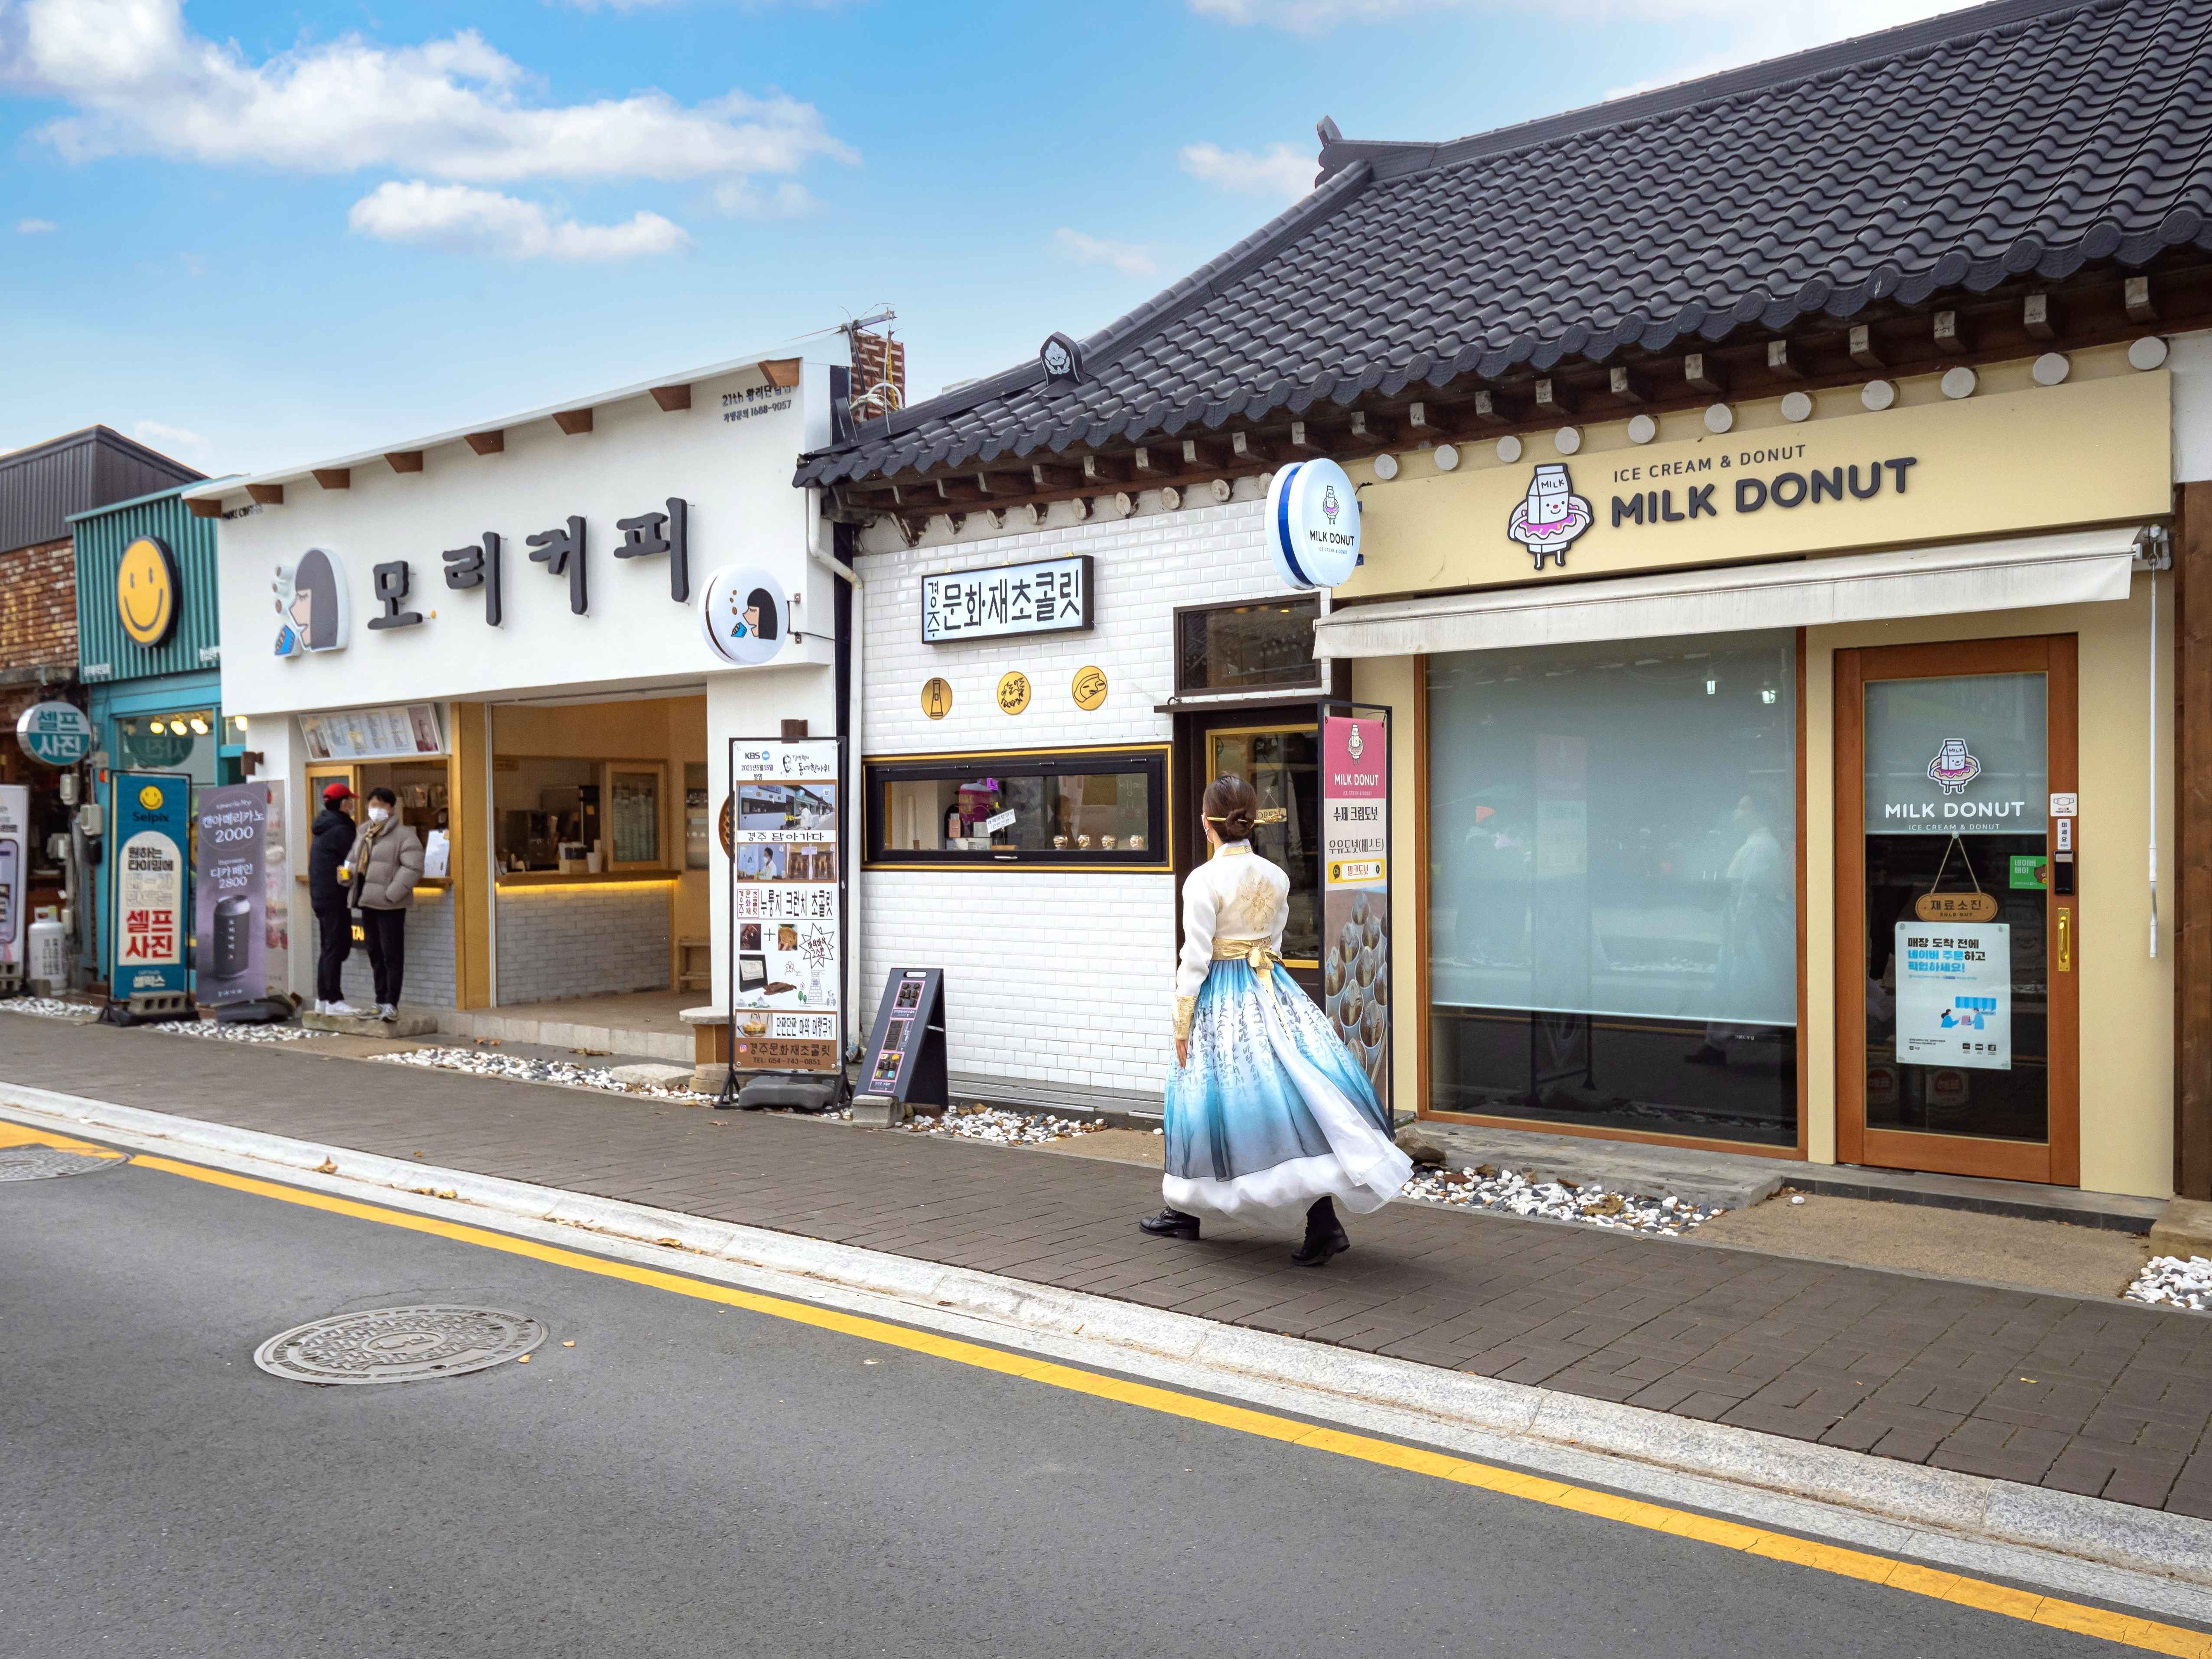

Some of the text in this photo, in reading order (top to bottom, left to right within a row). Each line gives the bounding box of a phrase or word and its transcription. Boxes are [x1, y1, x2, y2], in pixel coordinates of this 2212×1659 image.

[1613, 444, 1806, 483] ICE CREAM & DONUT
[1541, 479, 1565, 489] MILK
[1611, 456, 1917, 528] MILK DONUT
[1310, 530, 1355, 546] MILK DONUT
[38, 711, 80, 731] 셀프
[37, 735, 81, 756] 사진
[1334, 773, 1379, 786] MILK DONUT
[1333, 806, 1378, 821] 수제 크림도넛
[1885, 802, 2025, 818] MILK DONUT
[132, 812, 169, 824] Selpix
[215, 826, 254, 843] 2000
[747, 832, 824, 841] 경주 담아가다
[128, 846, 162, 859] 원하는
[1329, 838, 1384, 854] 우유도넛(베스트)
[127, 860, 174, 871] 타이밍에
[1348, 864, 1368, 876] 밀크도넛
[218, 876, 248, 889] 2800
[760, 890, 832, 917] 누룽지 크런치 초콜릿
[1930, 900, 1982, 910] 재료소진
[126, 909, 173, 933] 셀프
[125, 935, 173, 958] 사진
[1908, 938, 1979, 949] 매장 도착 전에
[1908, 949, 1986, 961] 네이버 주문하고
[1908, 961, 1965, 973] 픽업하세요!
